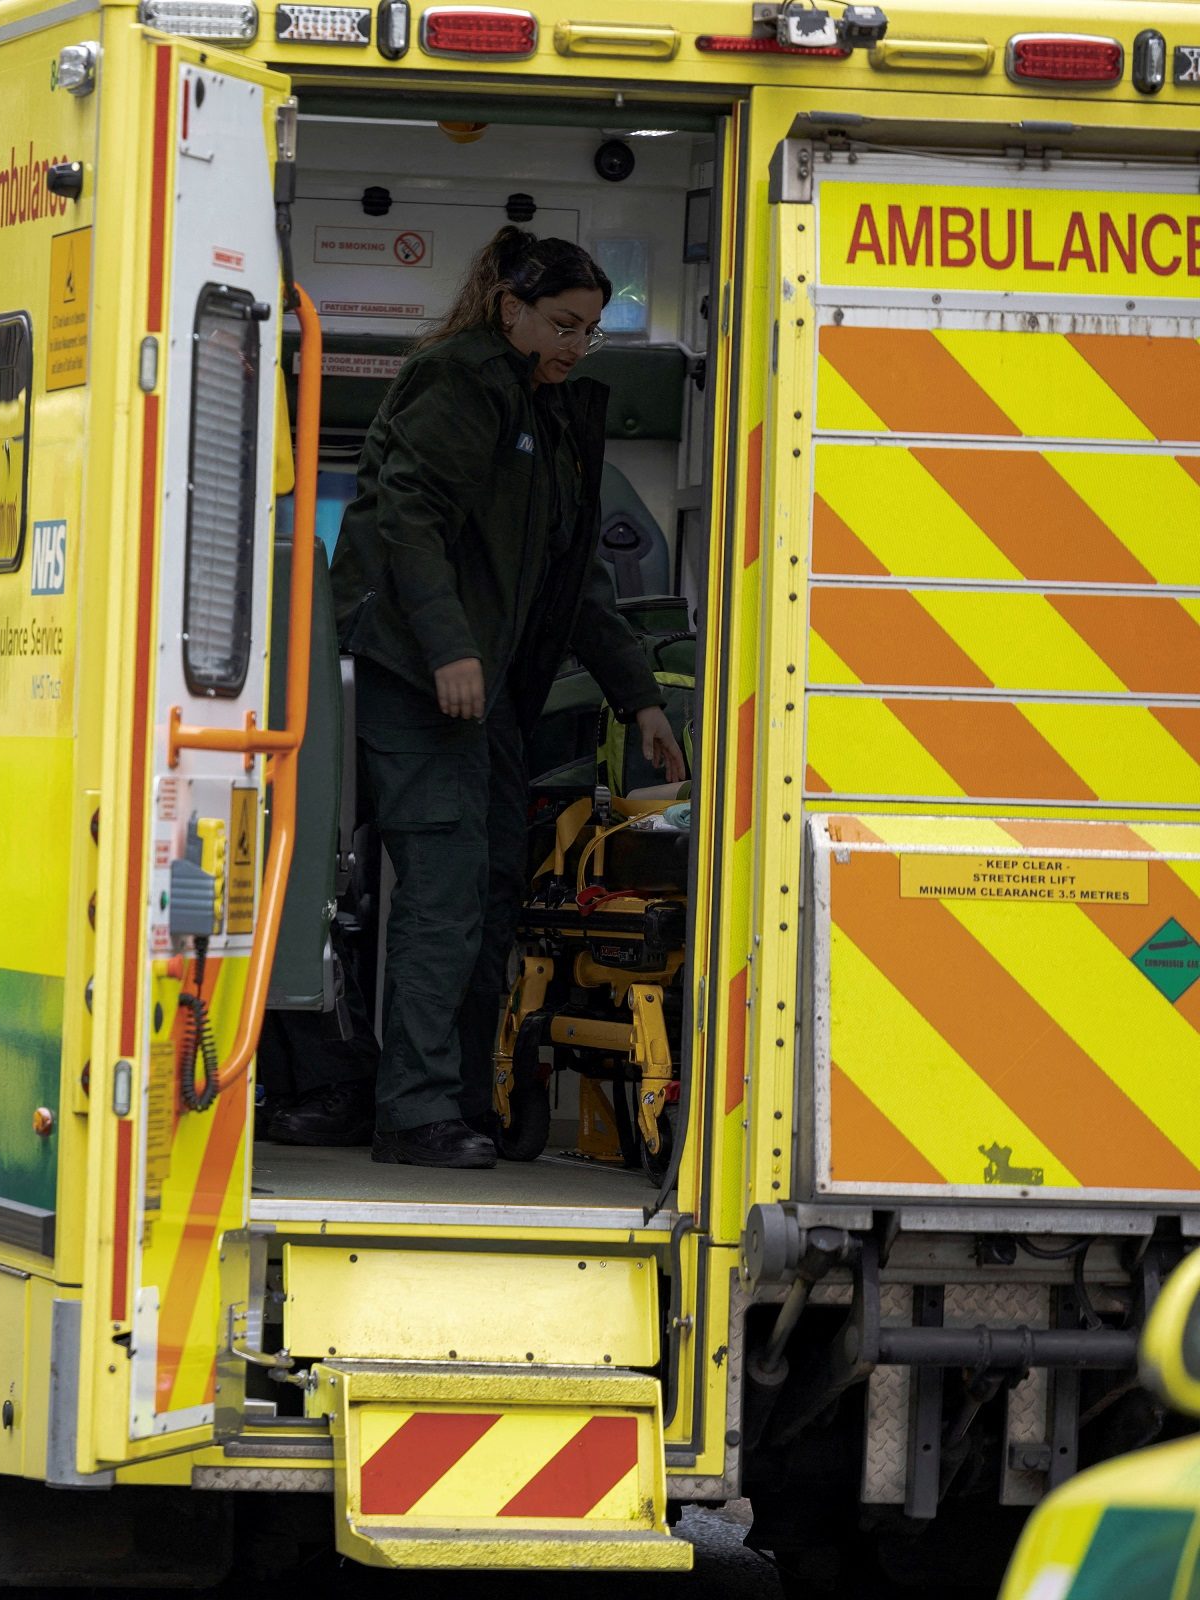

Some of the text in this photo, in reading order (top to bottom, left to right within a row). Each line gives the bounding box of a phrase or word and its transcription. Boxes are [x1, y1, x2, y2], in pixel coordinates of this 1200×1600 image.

[321, 241, 385, 251] NO SMOKING
[325, 303, 359, 311] PATIENT
[360, 304, 403, 313] HANDLING
[328, 356, 351, 364] DOOR
[354, 357, 376, 365] MUST
[379, 358, 391, 366] BE
[327, 365, 360, 373] VEHICLE
[363, 366, 371, 374] IS
[32, 524, 66, 590] NHS
[31, 616, 63, 656] Service
[986, 860, 1062, 870] KEEP CLEAR
[973, 873, 1076, 885] STRETCHER LIFT
[919, 886, 1130, 900] MINIMUM CLEARANCE 3.5 METRES
